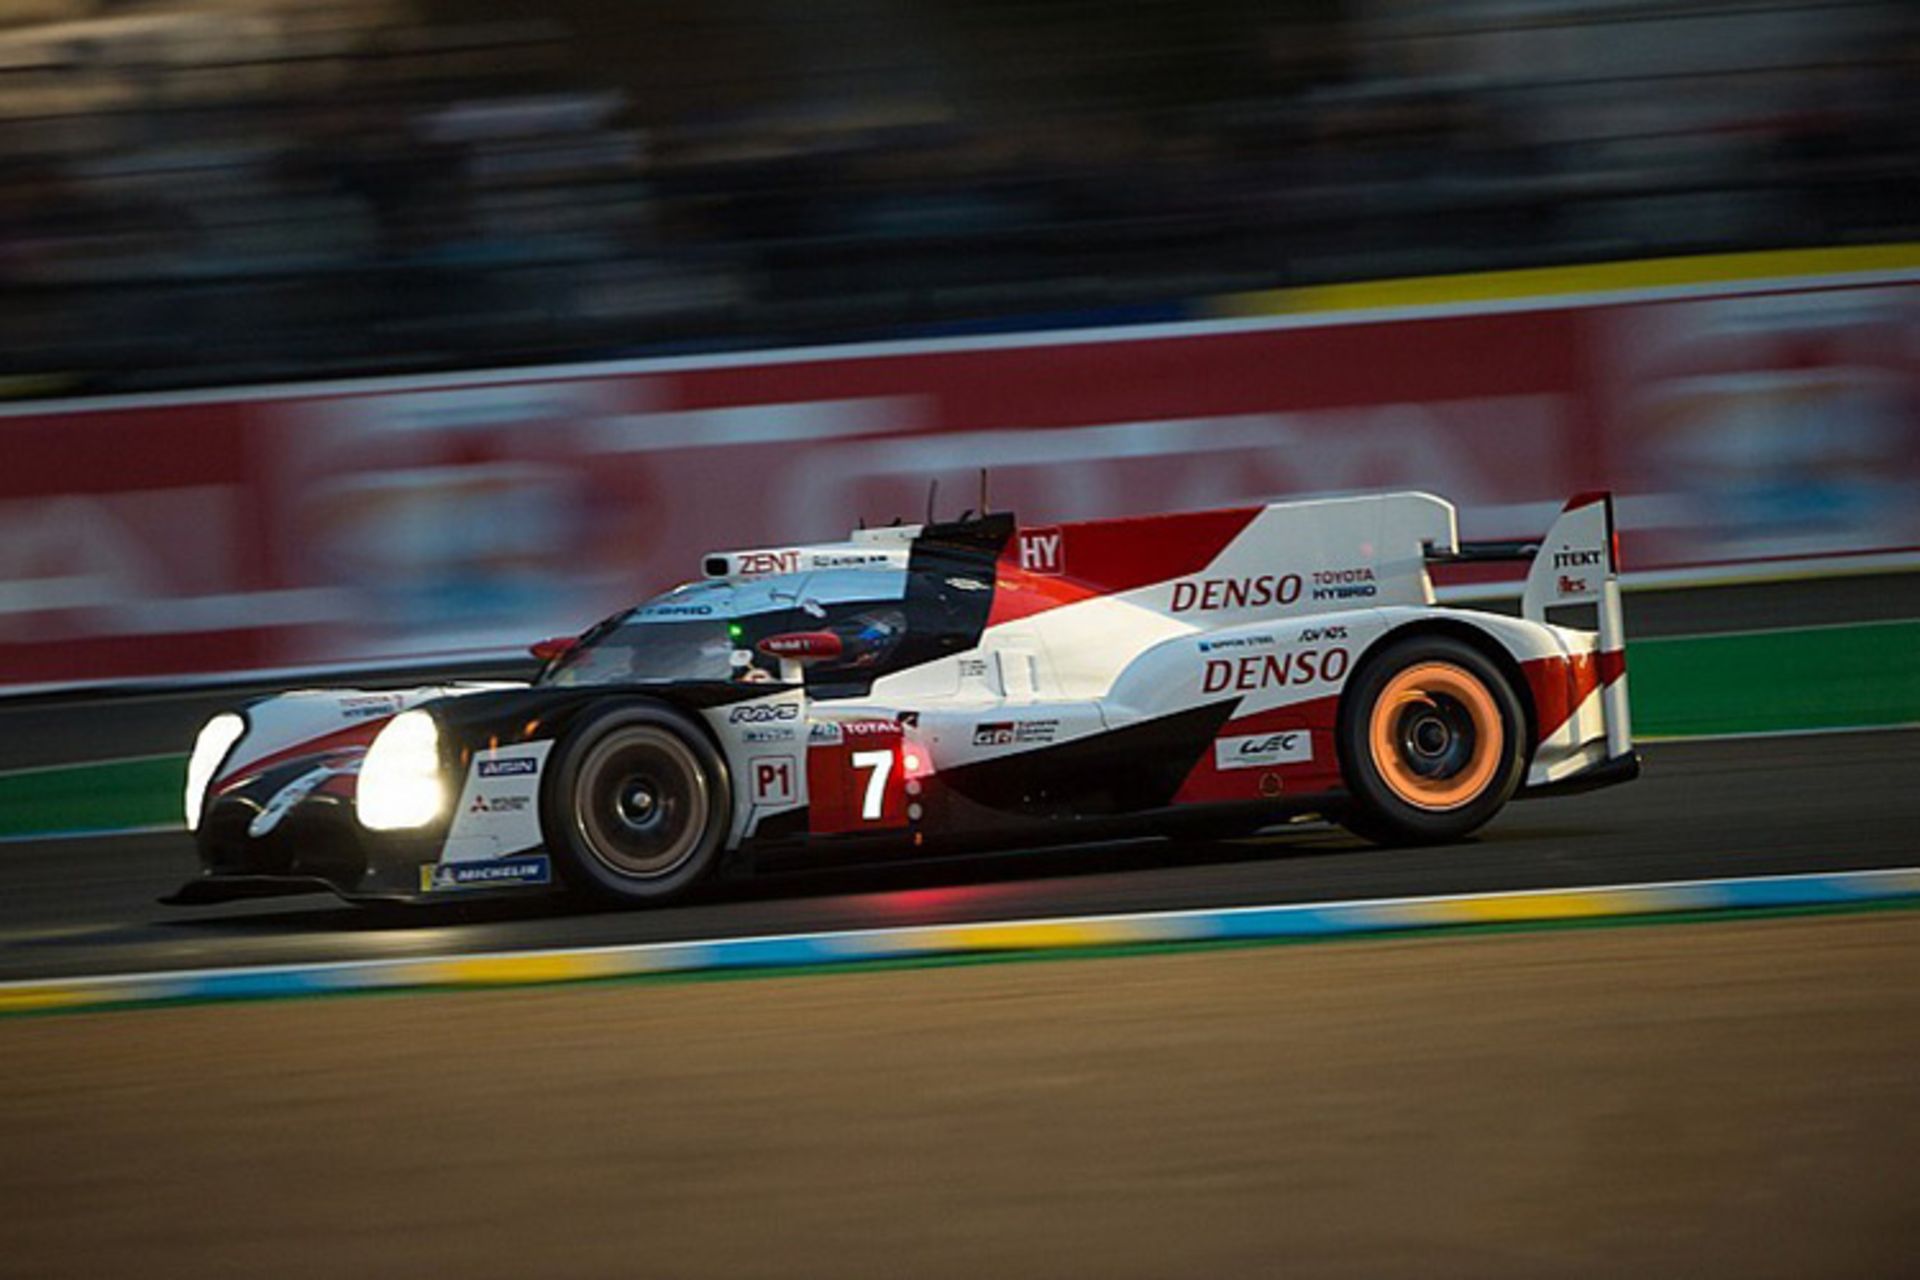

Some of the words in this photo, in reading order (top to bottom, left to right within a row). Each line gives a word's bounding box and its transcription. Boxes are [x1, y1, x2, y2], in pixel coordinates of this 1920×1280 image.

[738, 550, 800, 577] ZENT
[1020, 534, 1059, 570] HY
[1554, 545, 1601, 571] JTEKT
[1312, 568, 1375, 584] TOYOTA
[1170, 573, 1303, 613] DENSO
[1312, 585, 1377, 600] HYBRID
[1202, 647, 1349, 694] DENSO
[845, 721, 901, 736] TOTAL
[1240, 734, 1299, 754] WEC
[482, 760, 535, 775] AISIN
[757, 764, 789, 797] P1
[852, 749, 894, 820] 7
[458, 864, 540, 880] MICHELIN
